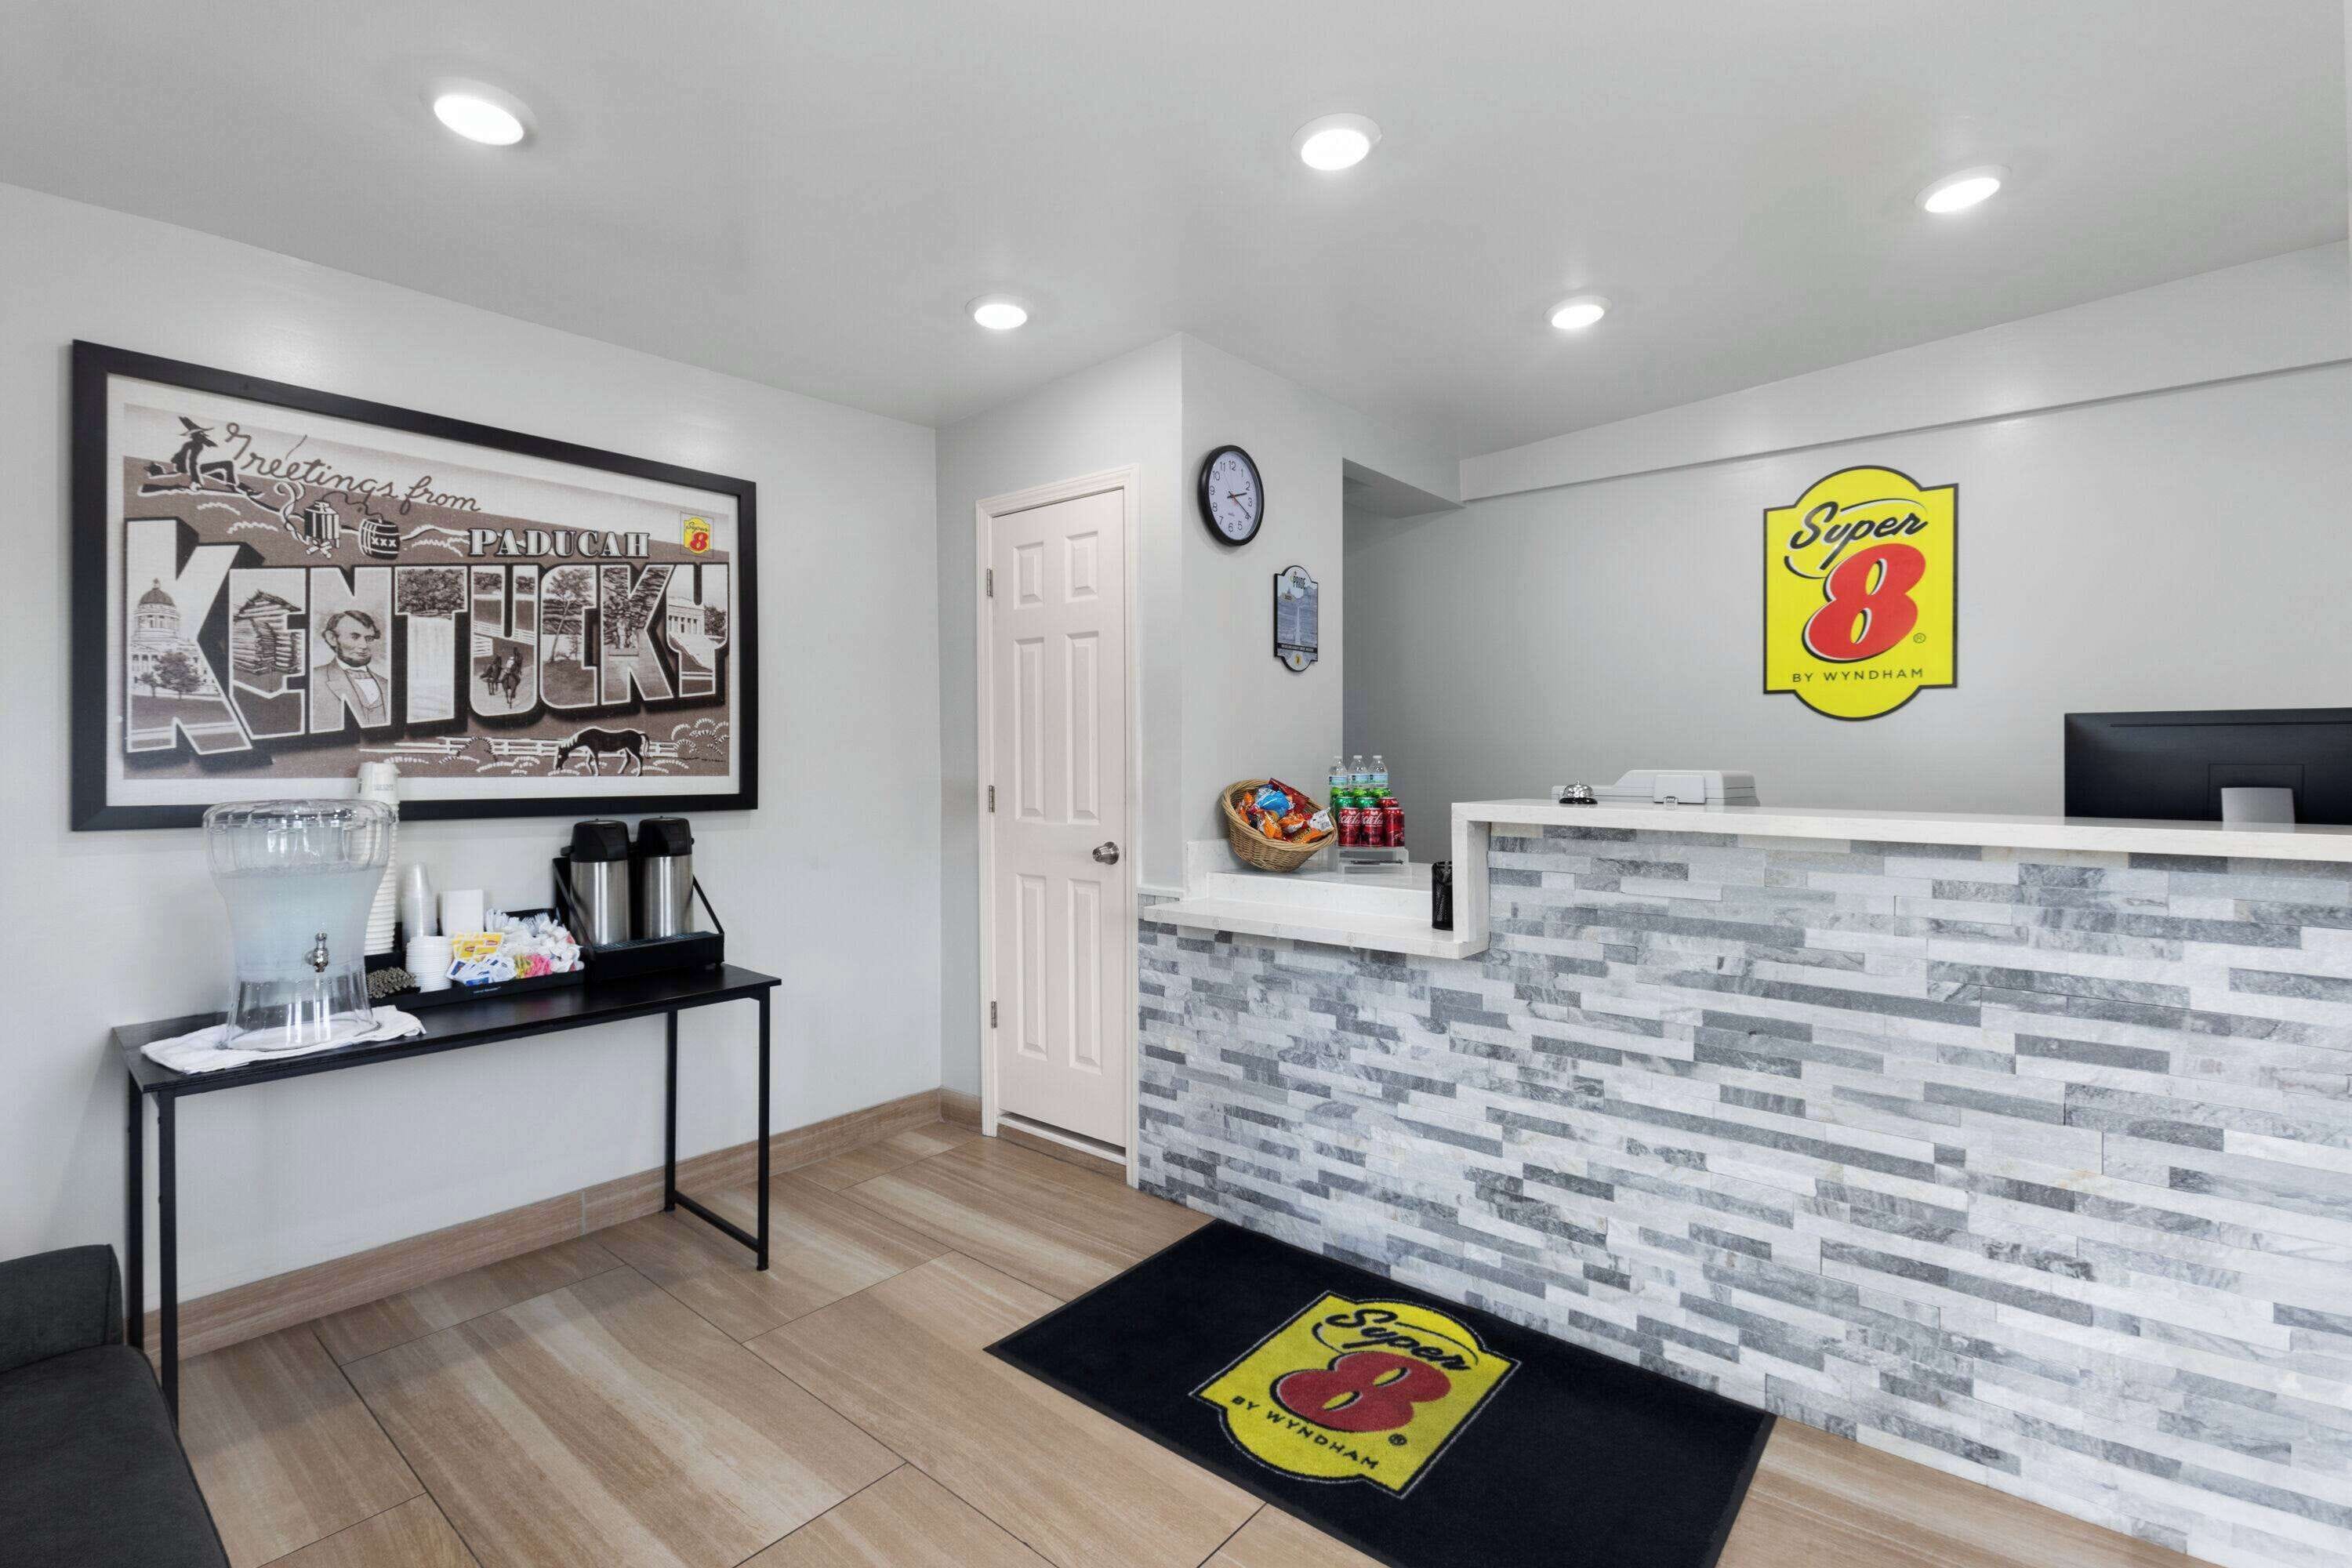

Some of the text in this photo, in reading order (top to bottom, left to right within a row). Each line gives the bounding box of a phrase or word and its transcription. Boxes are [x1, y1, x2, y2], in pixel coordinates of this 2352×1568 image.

[224, 422, 482, 516] Greetings from
[1220, 461, 1226, 472] 11
[1229, 460, 1236, 471] 12
[1212, 470, 1221, 481] 10
[1210, 485, 1215, 495] 9
[1245, 481, 1250, 492] 2
[1212, 502, 1218, 513] 8
[1248, 497, 1253, 507] 3
[1219, 515, 1224, 525] 7
[1238, 521, 1243, 531] 5
[1228, 522, 1234, 533] 6
[370, 535, 397, 548] XXX
[689, 531, 710, 552] 8
[1788, 501, 1929, 571] Super
[468, 527, 651, 560] PADUCAH
[1801, 543, 1927, 665] 8
[125, 518, 731, 757] KENTUCKY
[1791, 667, 1923, 683] BY WYNDHAM
[1325, 1308, 1472, 1371] Super
[1269, 1350, 1452, 1433] 8
[1231, 1395, 1380, 1470] BY WYNDHAM
